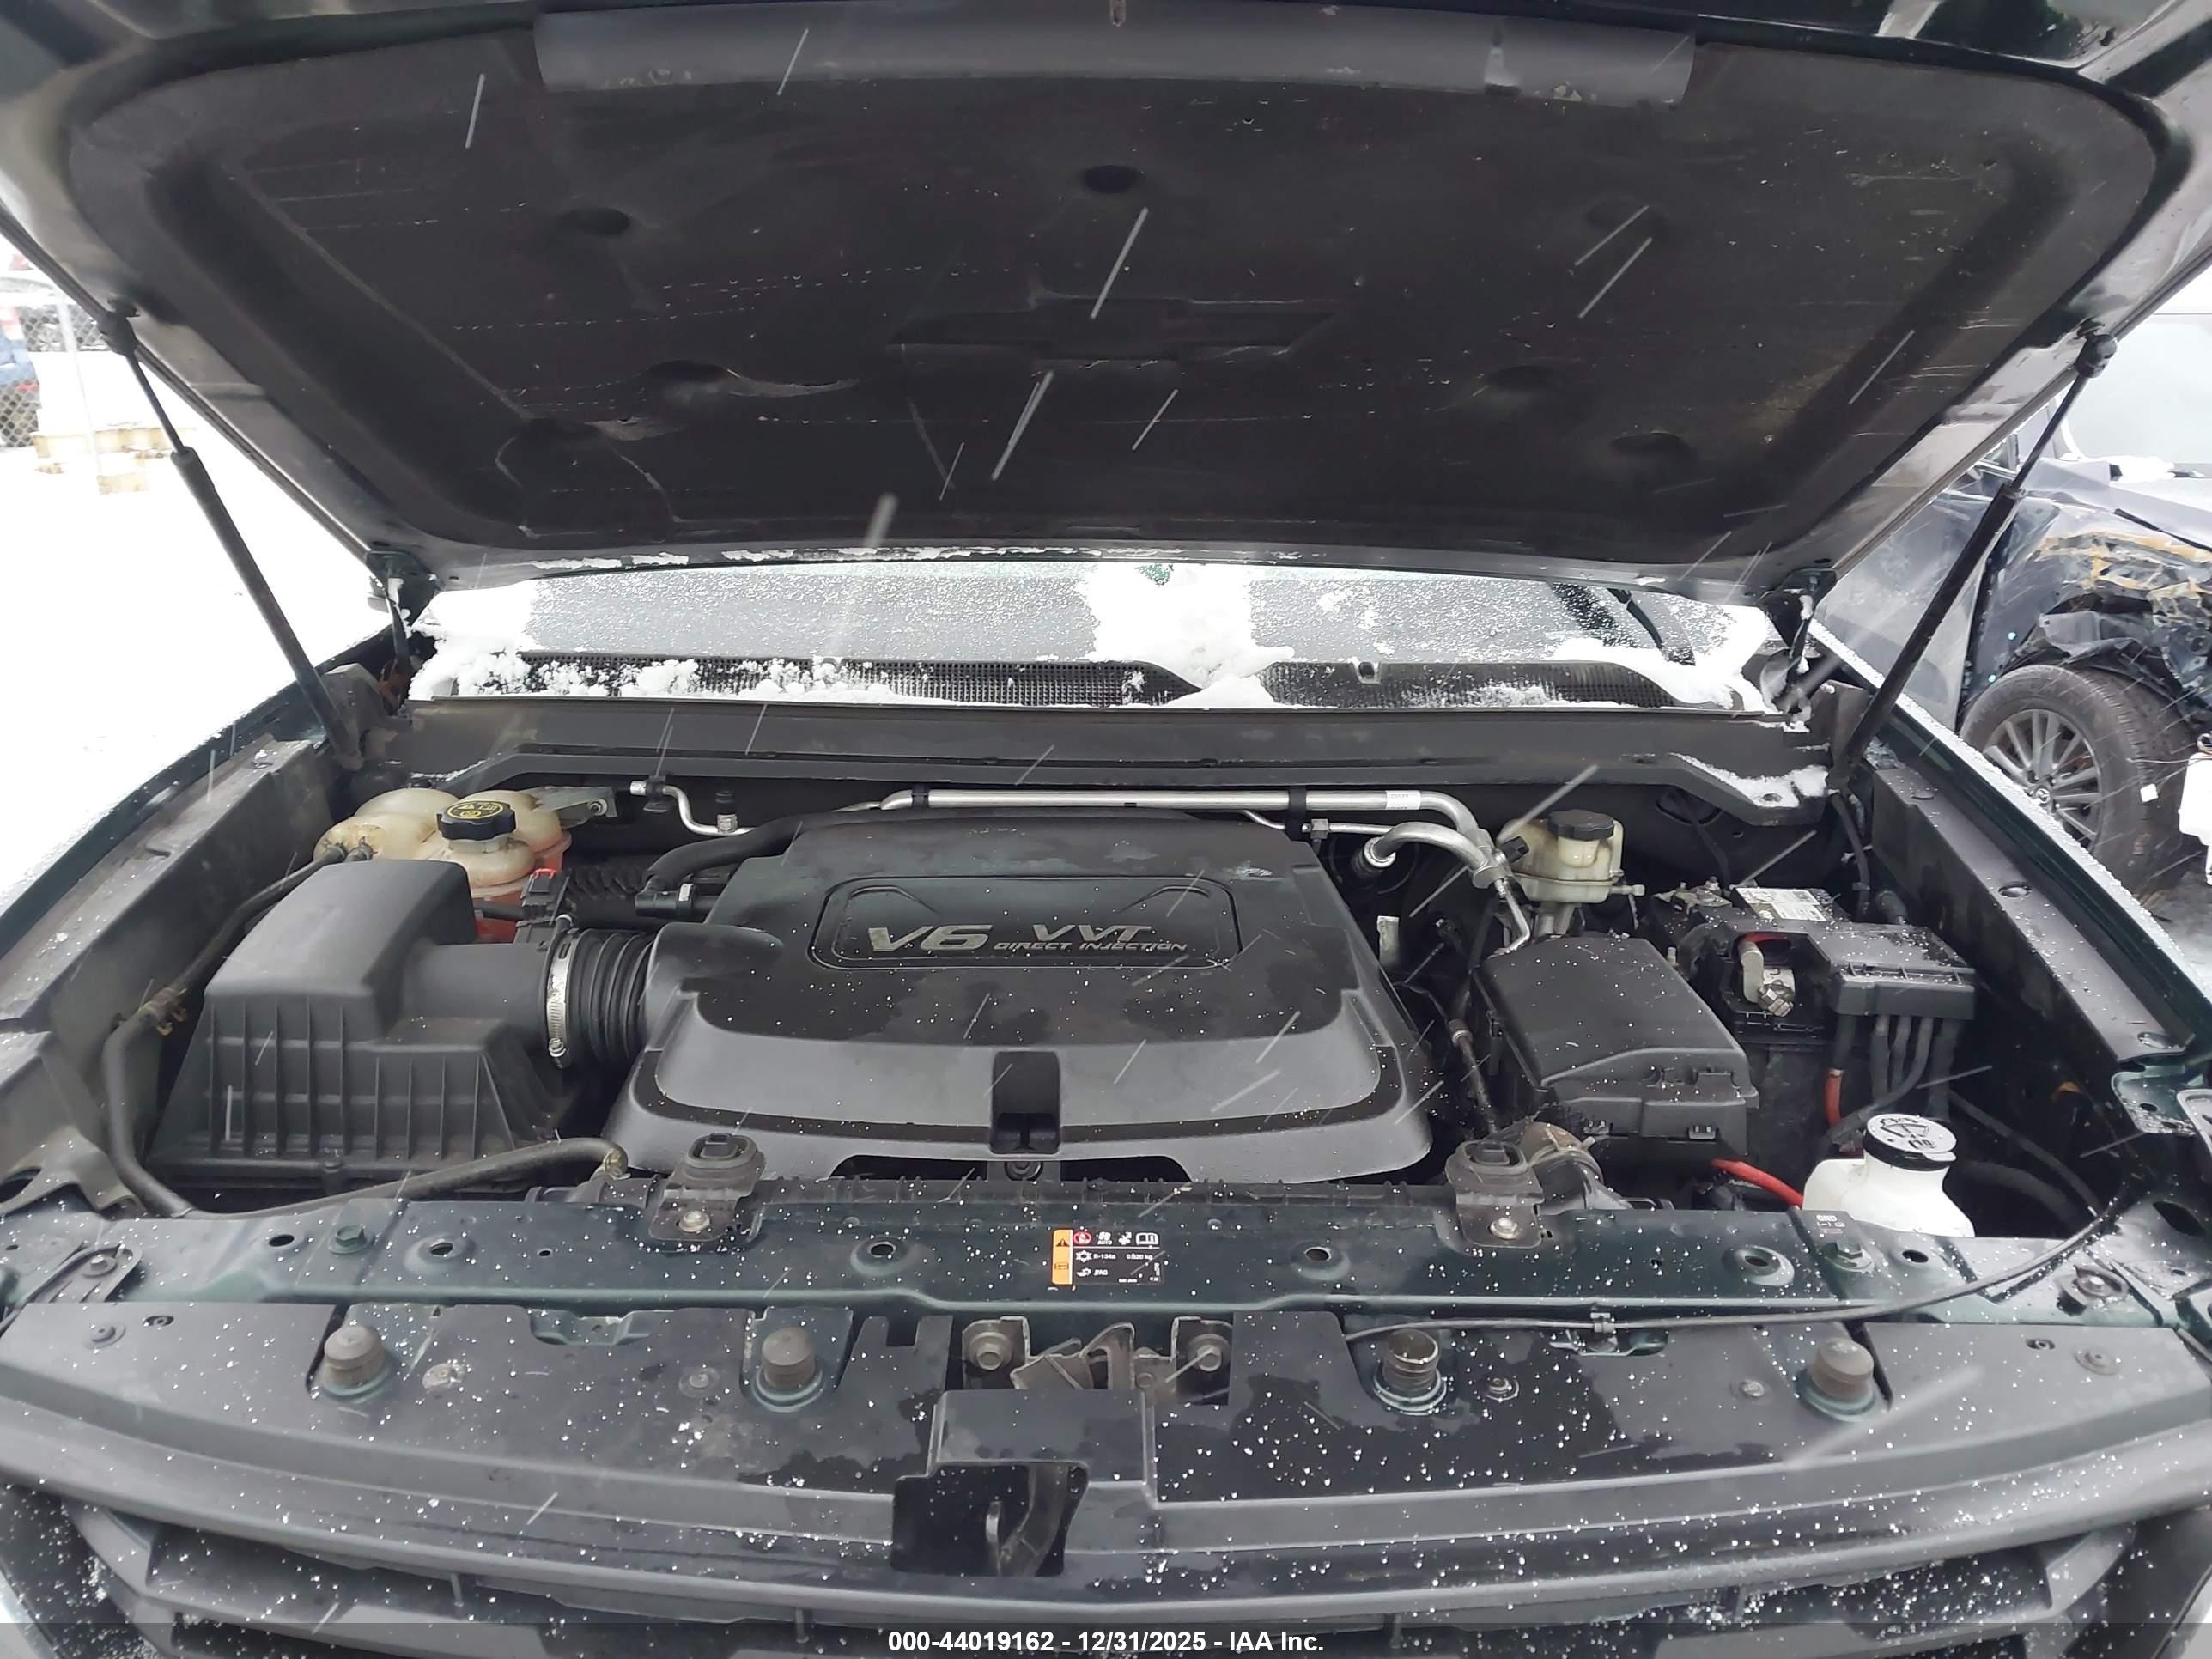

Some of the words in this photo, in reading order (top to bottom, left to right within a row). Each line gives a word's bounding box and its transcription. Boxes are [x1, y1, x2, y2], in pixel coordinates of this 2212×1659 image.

[868, 925, 993, 952] V6
[1033, 925, 1152, 941] VVT
[994, 942, 1073, 951] DIRECT
[1079, 941, 1187, 951] INJECTION
